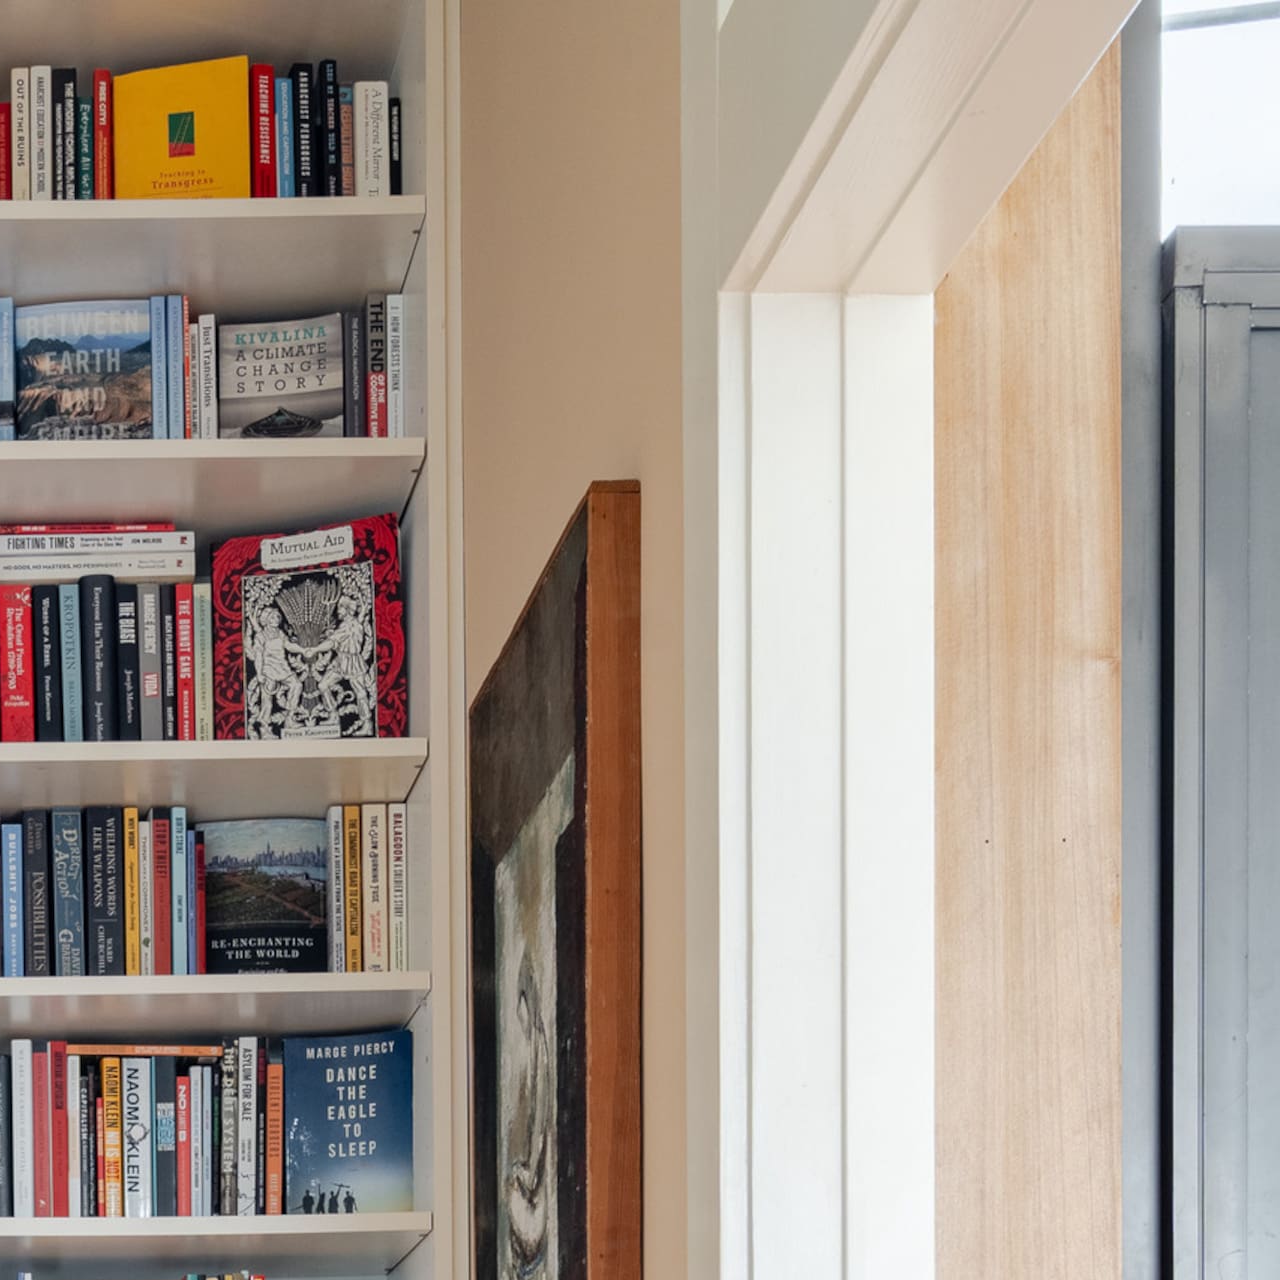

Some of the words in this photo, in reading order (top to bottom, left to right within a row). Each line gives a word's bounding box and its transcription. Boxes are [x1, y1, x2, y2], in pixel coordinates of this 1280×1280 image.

[16, 79, 25, 99] OUT
[259, 75, 270, 114] TEACHING
[299, 72, 310, 120] ANARCHIST
[371, 89, 381, 98] A
[16, 102, 23, 114] OF
[370, 100, 383, 144] Different
[17, 136, 25, 167] RUINS
[259, 116, 270, 164] RESISTANCE
[300, 123, 311, 177] PEDAGOGIES
[372, 147, 383, 180] Mirror
[369, 302, 383, 332] THE
[391, 316, 399, 333] HOW
[202, 326, 212, 346] Just
[234, 325, 327, 346] KIVALINA
[235, 348, 247, 362] A
[252, 342, 328, 361] CLIMATE
[370, 339, 385, 372] END
[391, 335, 400, 367] FORESTS
[204, 348, 213, 408] Transitions
[235, 360, 327, 378] CHANGE
[391, 369, 400, 391] THINK
[236, 374, 327, 394] STORY
[7, 537, 45, 550] FIGHTING
[48, 536, 75, 550] TIMES
[63, 595, 76, 670] KROPOTKIN
[119, 618, 136, 644] BLAST
[93, 827, 103, 852] LIKE
[106, 817, 116, 874] WIELDING
[93, 853, 103, 908] WEAPONS
[107, 877, 116, 916] WORDS
[32, 871, 46, 972] POSSIBILITIES
[225, 951, 252, 960] THE
[256, 950, 300, 958] WORLD
[306, 1046, 348, 1059] MARGE
[354, 1041, 395, 1056] PIERCY
[326, 1064, 376, 1083] DANCE
[337, 1085, 367, 1101] THE
[327, 1103, 376, 1120] EAGLE
[343, 1123, 362, 1138] TO
[328, 1140, 376, 1158] SLEEP
